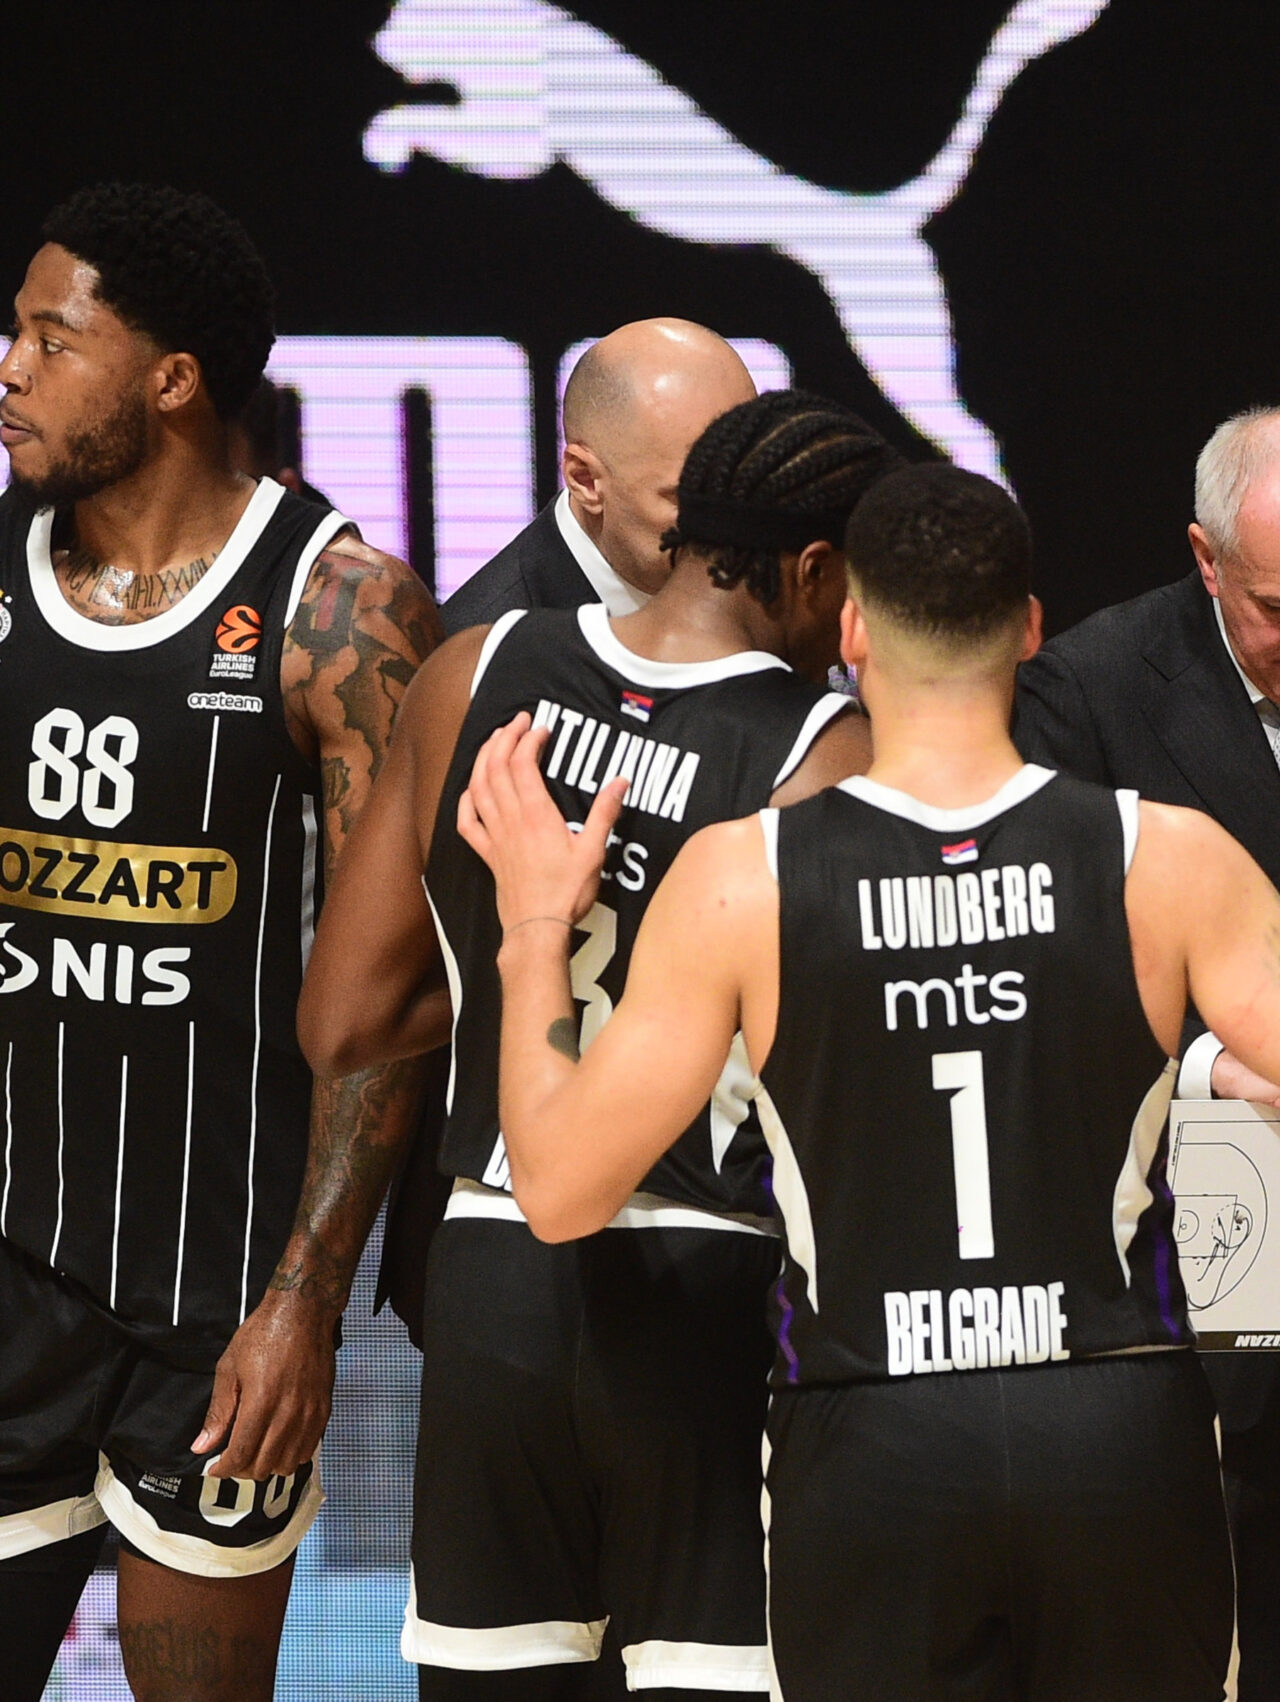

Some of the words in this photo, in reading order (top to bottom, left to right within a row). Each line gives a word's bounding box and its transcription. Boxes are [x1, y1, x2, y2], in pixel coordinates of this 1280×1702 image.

[211, 661, 254, 672] AIRLINES
[213, 653, 256, 664] TURKISH
[28, 708, 139, 828] 88
[857, 863, 1056, 950] LUNDBERG
[52, 937, 191, 1006] NIS
[884, 963, 1028, 1030] mts
[931, 1050, 995, 1260] 1
[883, 1281, 1070, 1376] BELGRADE
